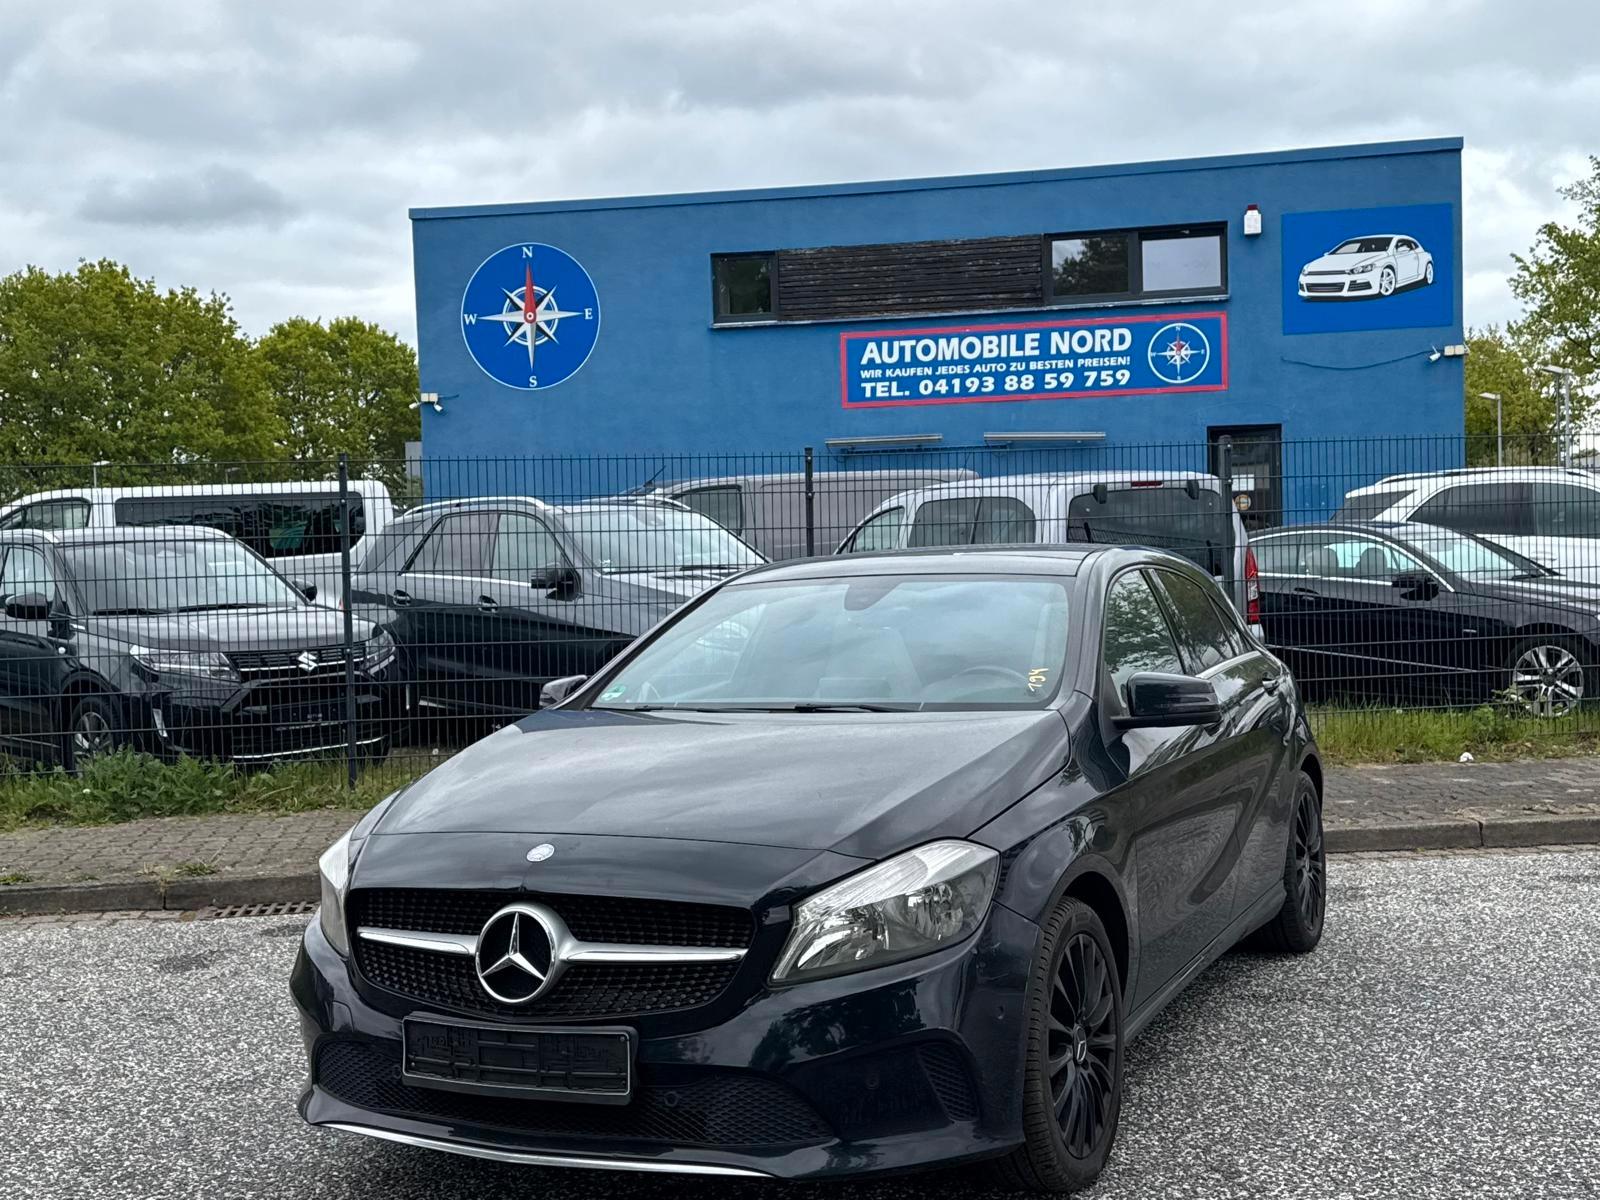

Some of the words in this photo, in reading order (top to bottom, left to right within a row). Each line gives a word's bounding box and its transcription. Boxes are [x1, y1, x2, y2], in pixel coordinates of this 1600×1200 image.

[522, 246, 533, 258] N
[464, 313, 477, 325] W
[584, 308, 593, 320] E
[860, 333, 1041, 365] AUTOMOBILE
[1050, 328, 1132, 355] NORD
[860, 369, 882, 379] WIR
[885, 367, 933, 378] KAUFEN
[935, 364, 970, 375] JEDES
[973, 362, 1007, 373] AUTO
[1009, 362, 1026, 371] ZU
[1029, 359, 1074, 371] BESTEN
[1077, 356, 1131, 368] PREISEN!
[529, 375, 538, 387] S
[861, 381, 910, 397] TEL.
[919, 376, 995, 395] 04193
[1004, 374, 1035, 391] 88
[1044, 372, 1075, 389] 59
[1083, 369, 1131, 387] 759
